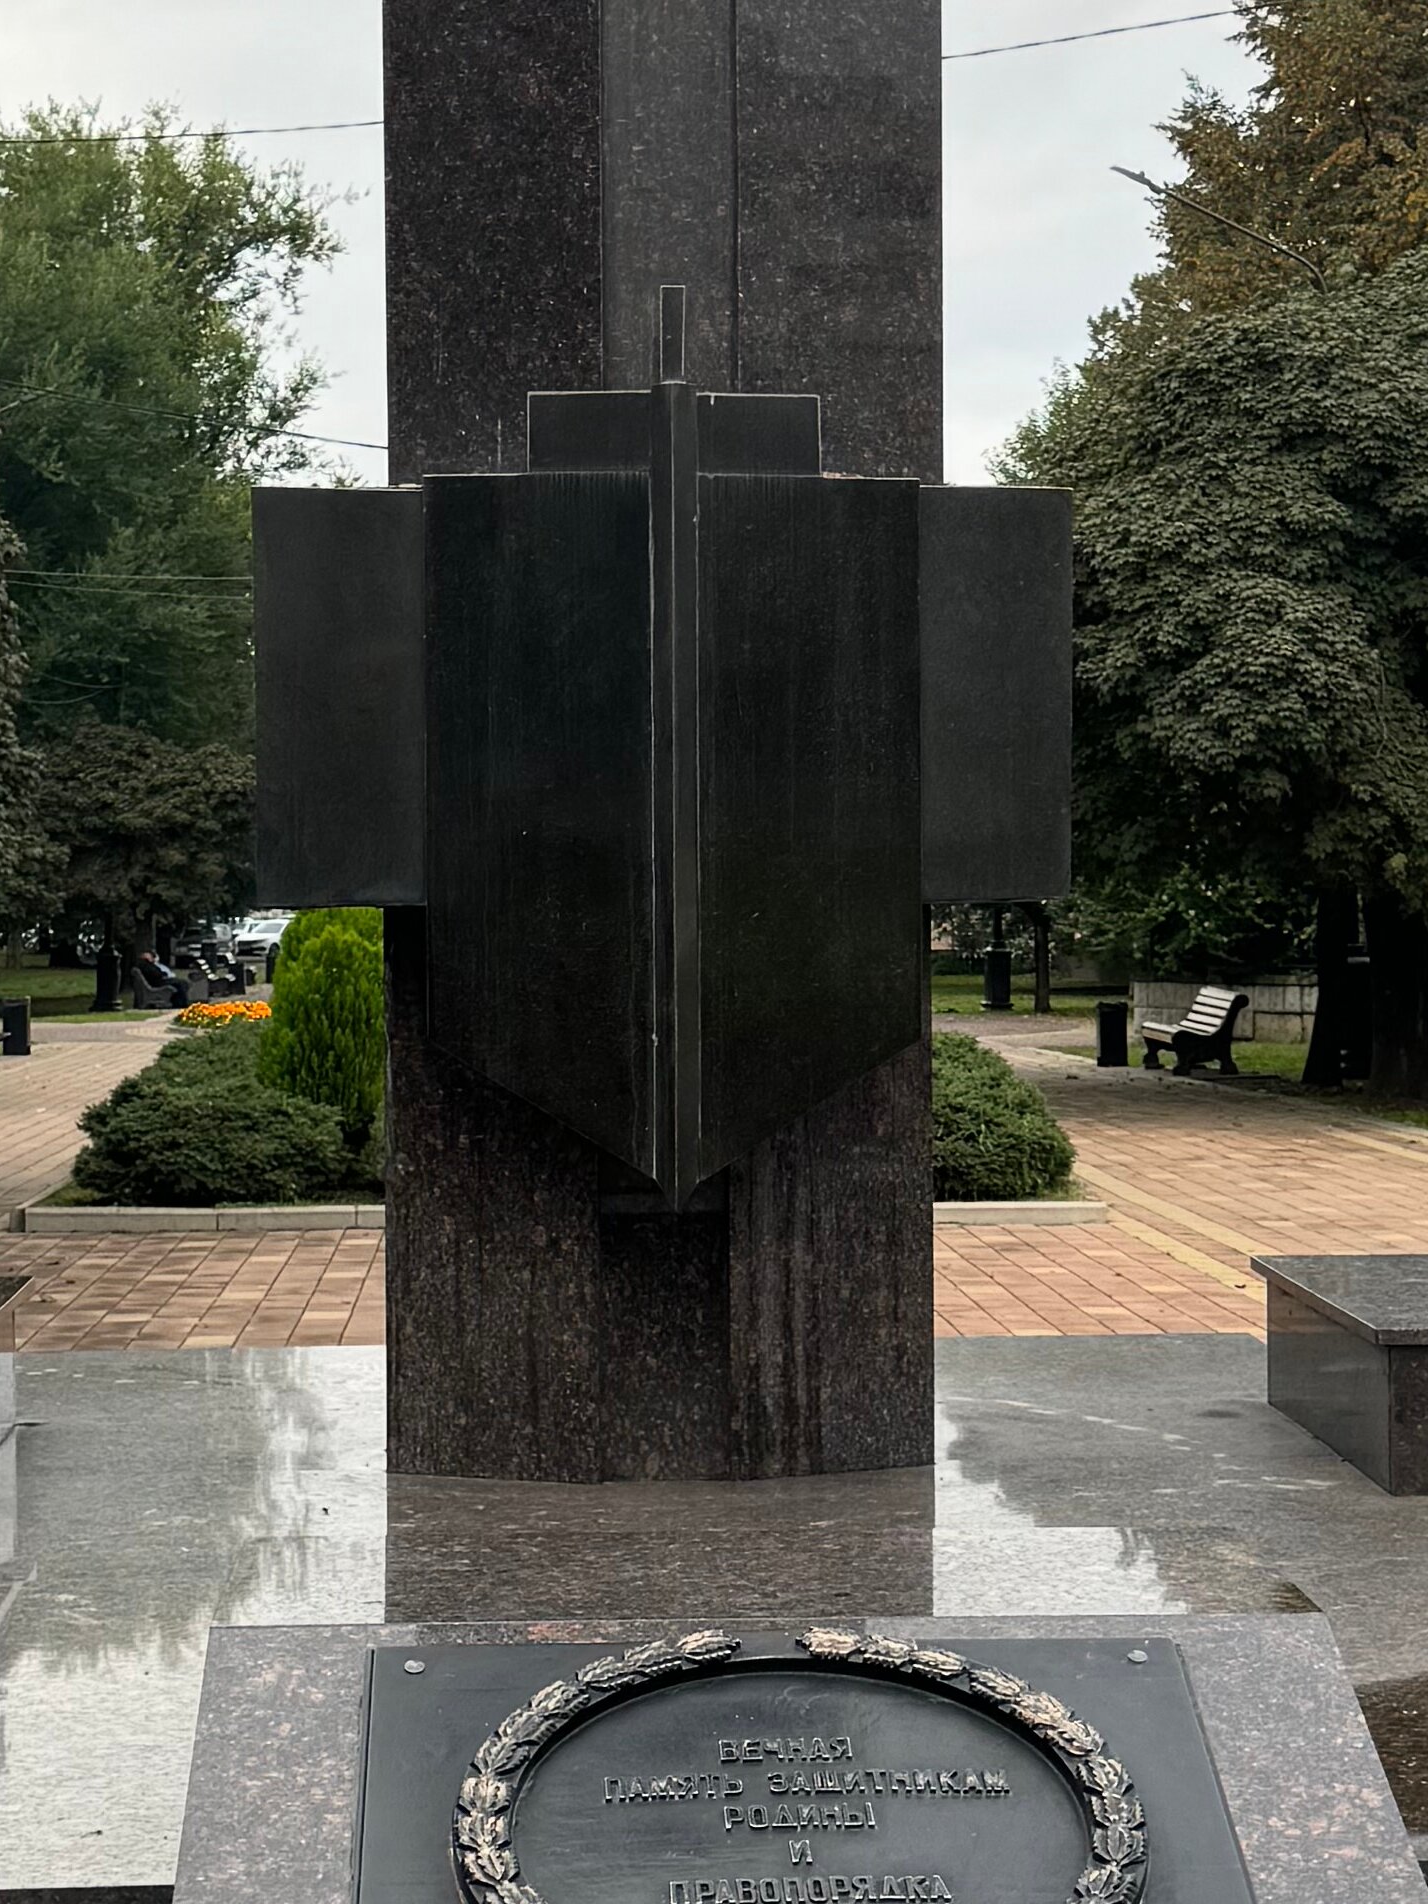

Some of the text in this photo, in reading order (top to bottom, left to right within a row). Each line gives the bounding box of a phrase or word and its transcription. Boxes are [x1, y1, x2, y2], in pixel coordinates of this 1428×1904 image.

[718, 1736, 852, 1762] ВЕЧНАЯ
[603, 1768, 1010, 1802] ПАМЯТЬ ЗАЩИТНИКАМ
[723, 1801, 877, 1831] РОДИНЫ
[788, 1839, 813, 1864] И
